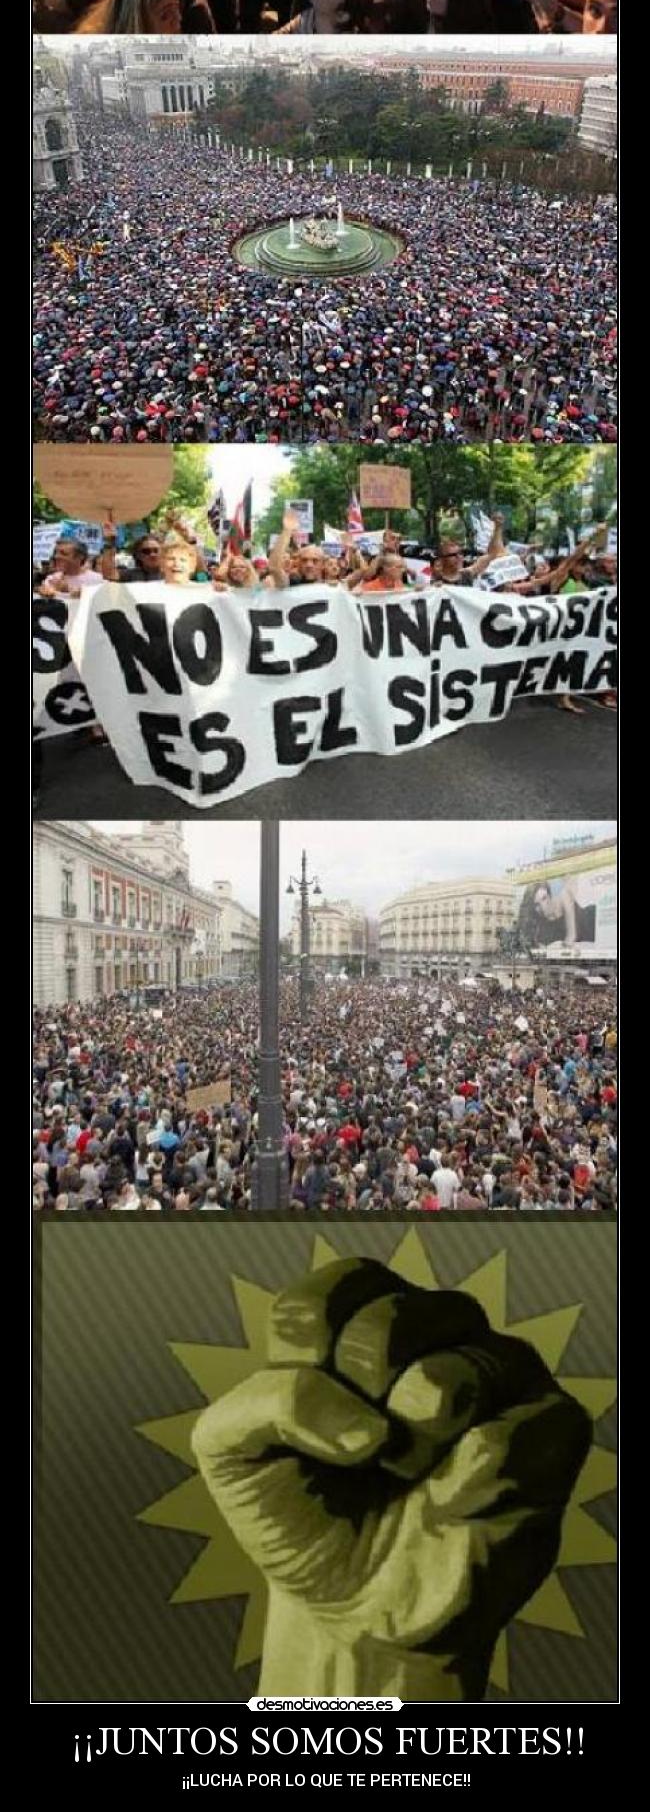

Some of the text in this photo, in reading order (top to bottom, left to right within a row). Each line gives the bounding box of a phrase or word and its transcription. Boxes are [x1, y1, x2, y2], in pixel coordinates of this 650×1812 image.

[97, 603, 223, 695] NO
[247, 600, 337, 675] ES
[356, 597, 469, 660] UNA
[138, 711, 246, 795] ES
[273, 687, 357, 766] EL
